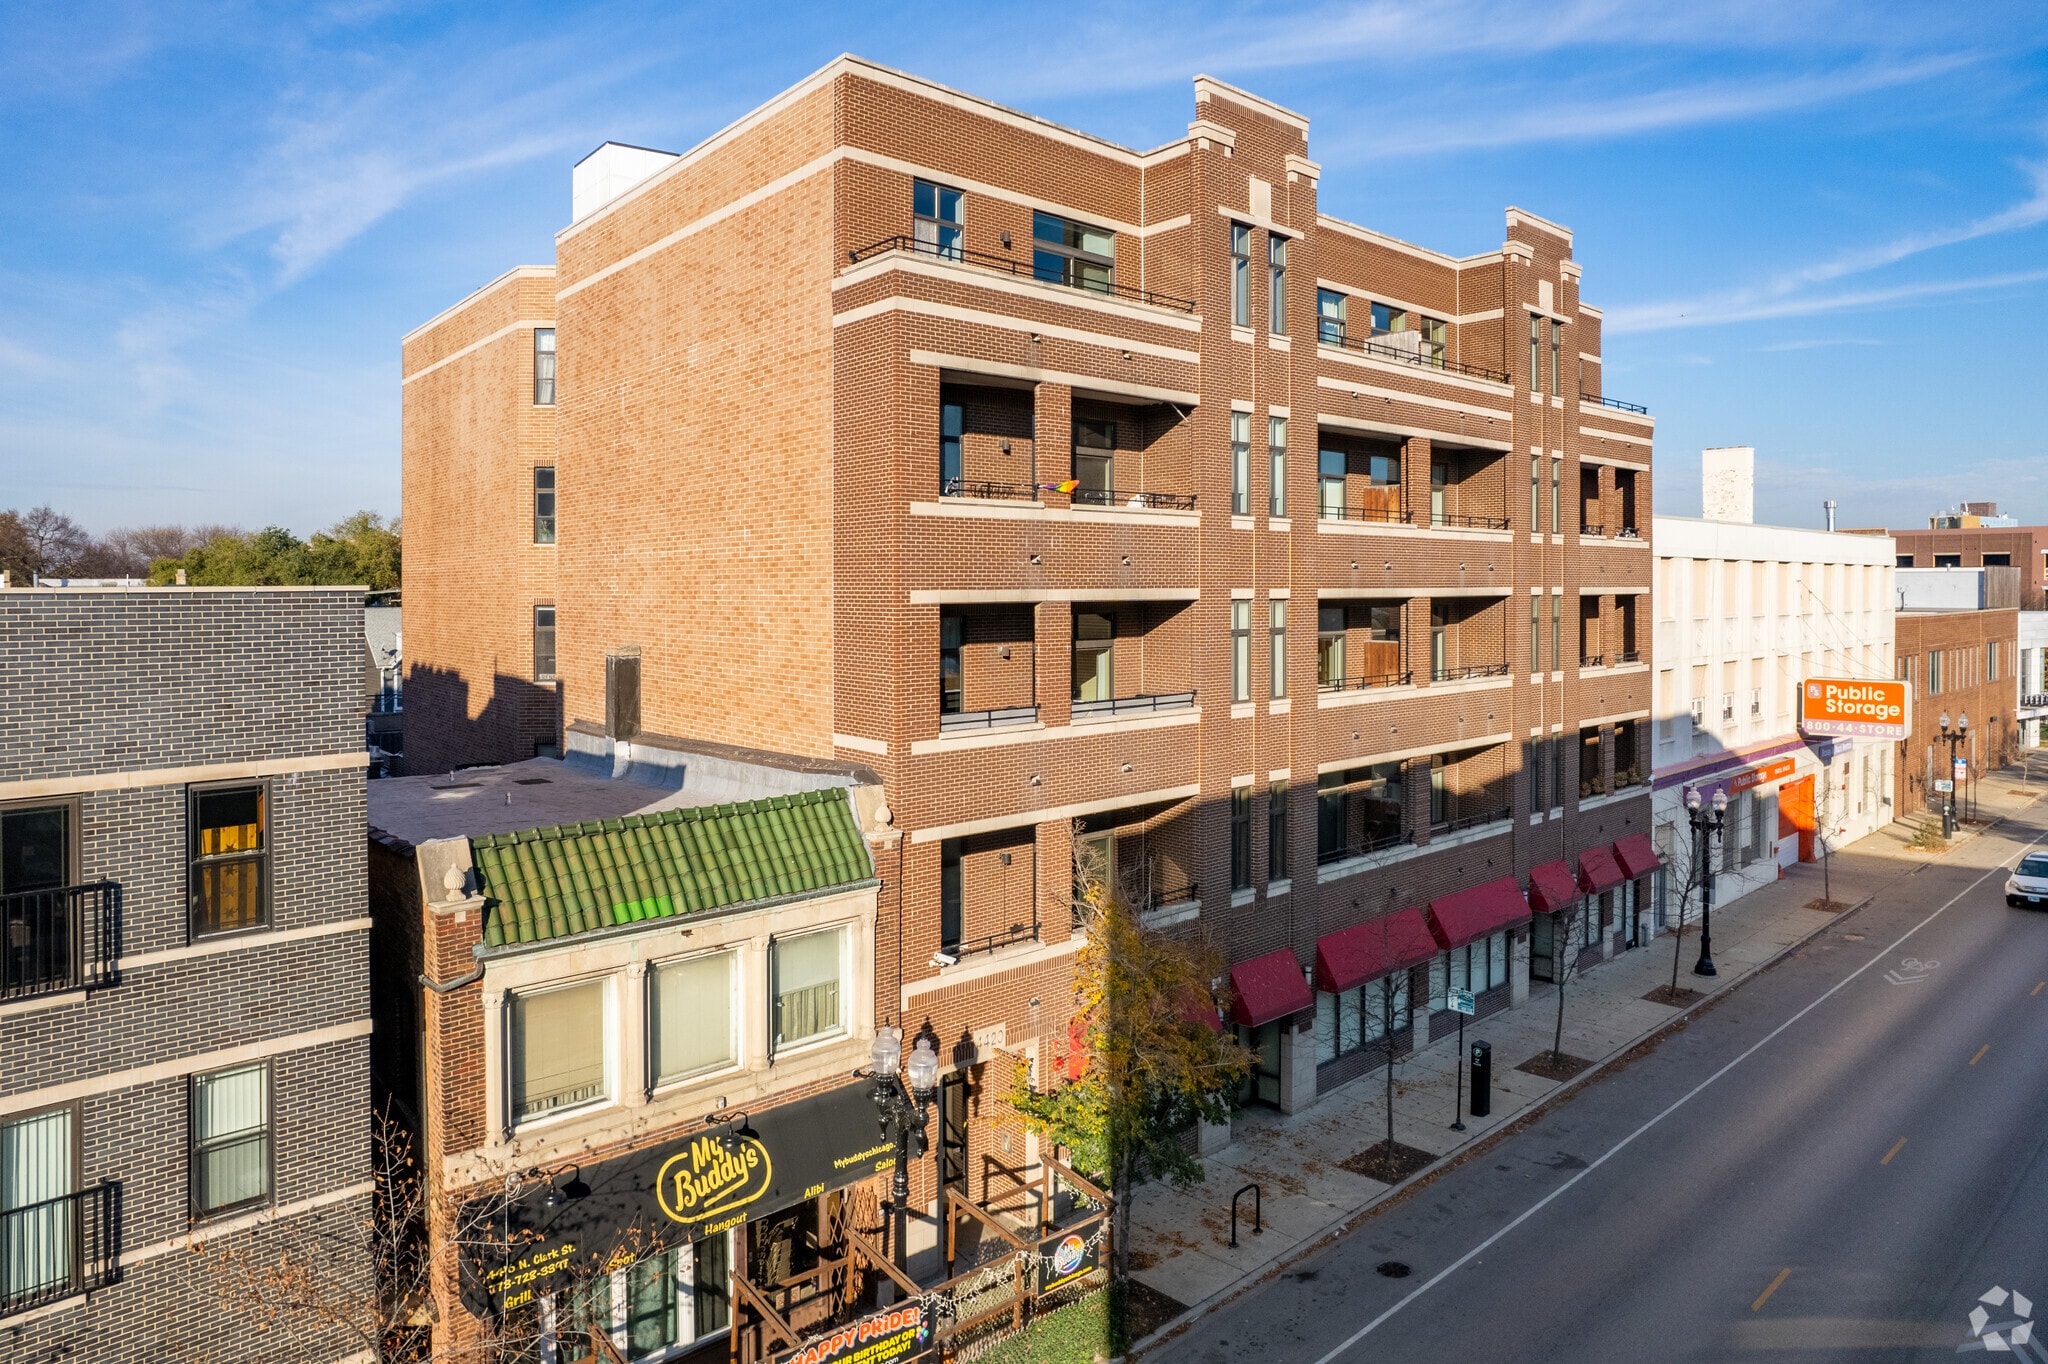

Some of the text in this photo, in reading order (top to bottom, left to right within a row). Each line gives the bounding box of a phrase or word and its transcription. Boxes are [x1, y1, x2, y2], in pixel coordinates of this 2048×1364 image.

[1826, 685, 1885, 702] Public
[1826, 699, 1901, 720] Storage
[691, 1136, 725, 1174] My
[875, 1158, 896, 1172] Salo
[674, 1143, 759, 1212] Buddy's
[804, 1183, 825, 1199] Alibi
[704, 1211, 748, 1236] Hangout
[518, 1259, 531, 1270] N.
[533, 1249, 560, 1265] Clark
[561, 1244, 577, 1255] St.
[505, 1289, 532, 1309] Grill
[853, 1334, 902, 1363] BIRTHDAY
[901, 1328, 916, 1341] OR
[876, 1340, 911, 1363] TODAY!
